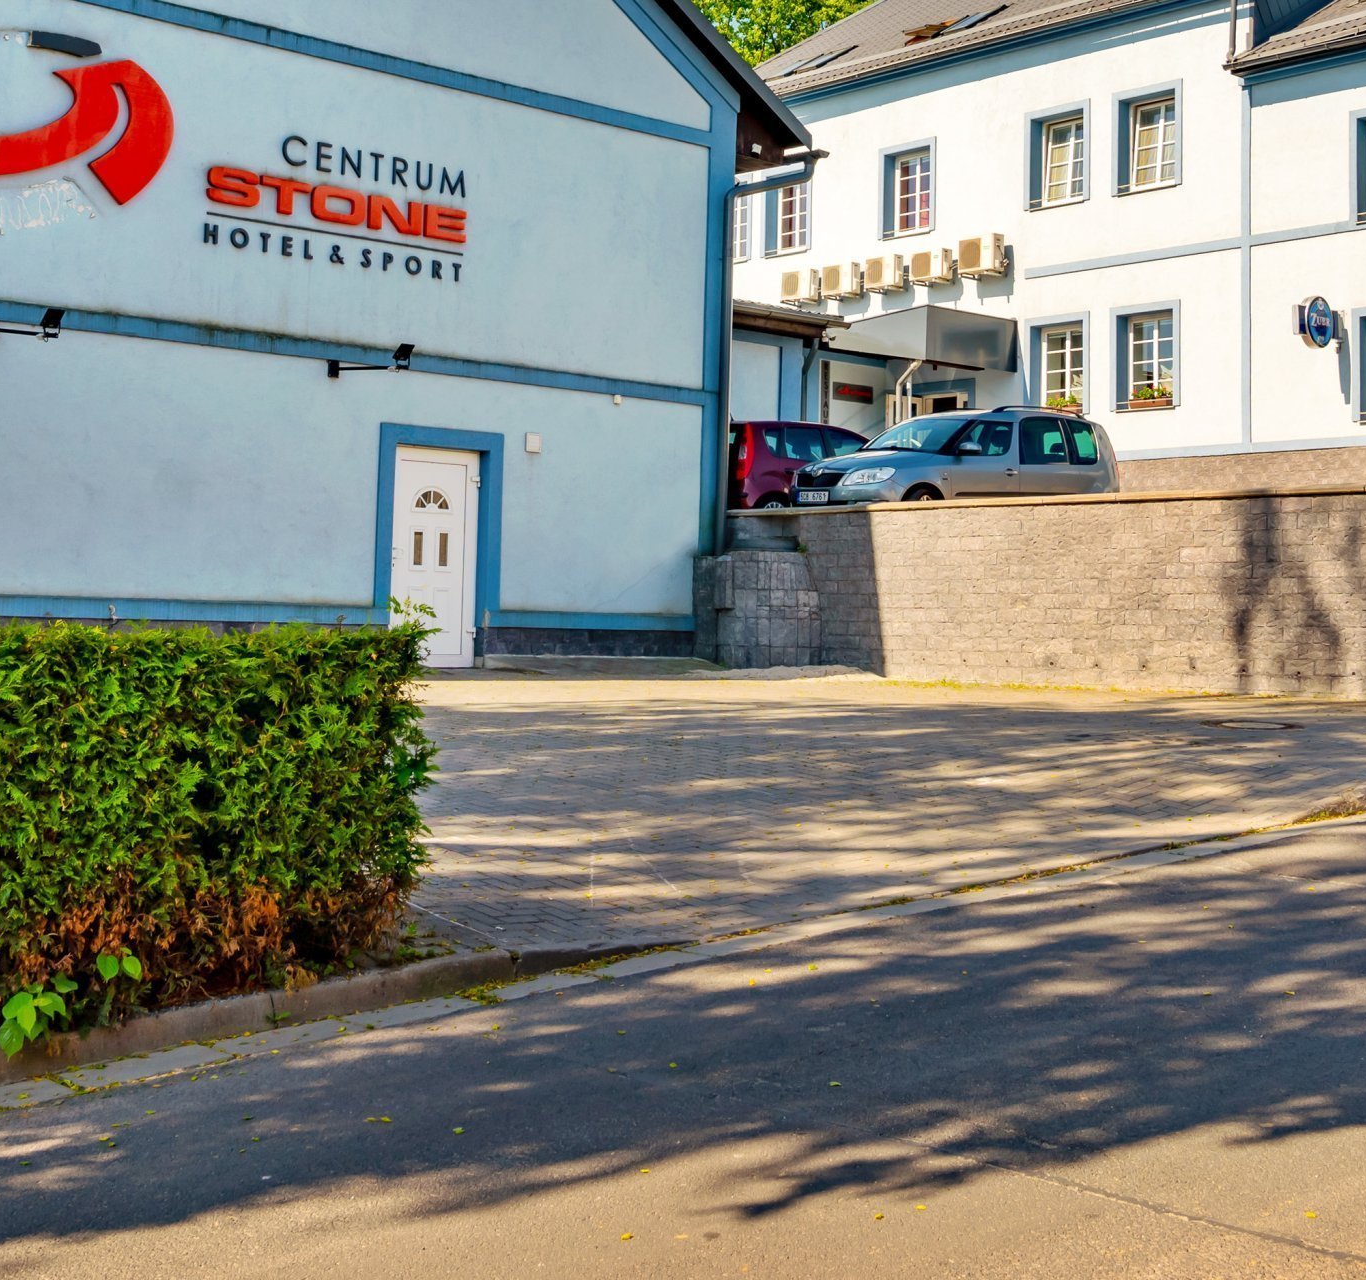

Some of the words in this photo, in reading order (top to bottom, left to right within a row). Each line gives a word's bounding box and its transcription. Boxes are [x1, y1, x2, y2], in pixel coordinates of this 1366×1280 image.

[282, 135, 467, 198] CENTRUM
[205, 166, 467, 243] STONE
[203, 223, 313, 260] HOTEL
[329, 244, 345, 265] &
[360, 248, 462, 282] SPORT
[1310, 312, 1330, 327] ZUBR
